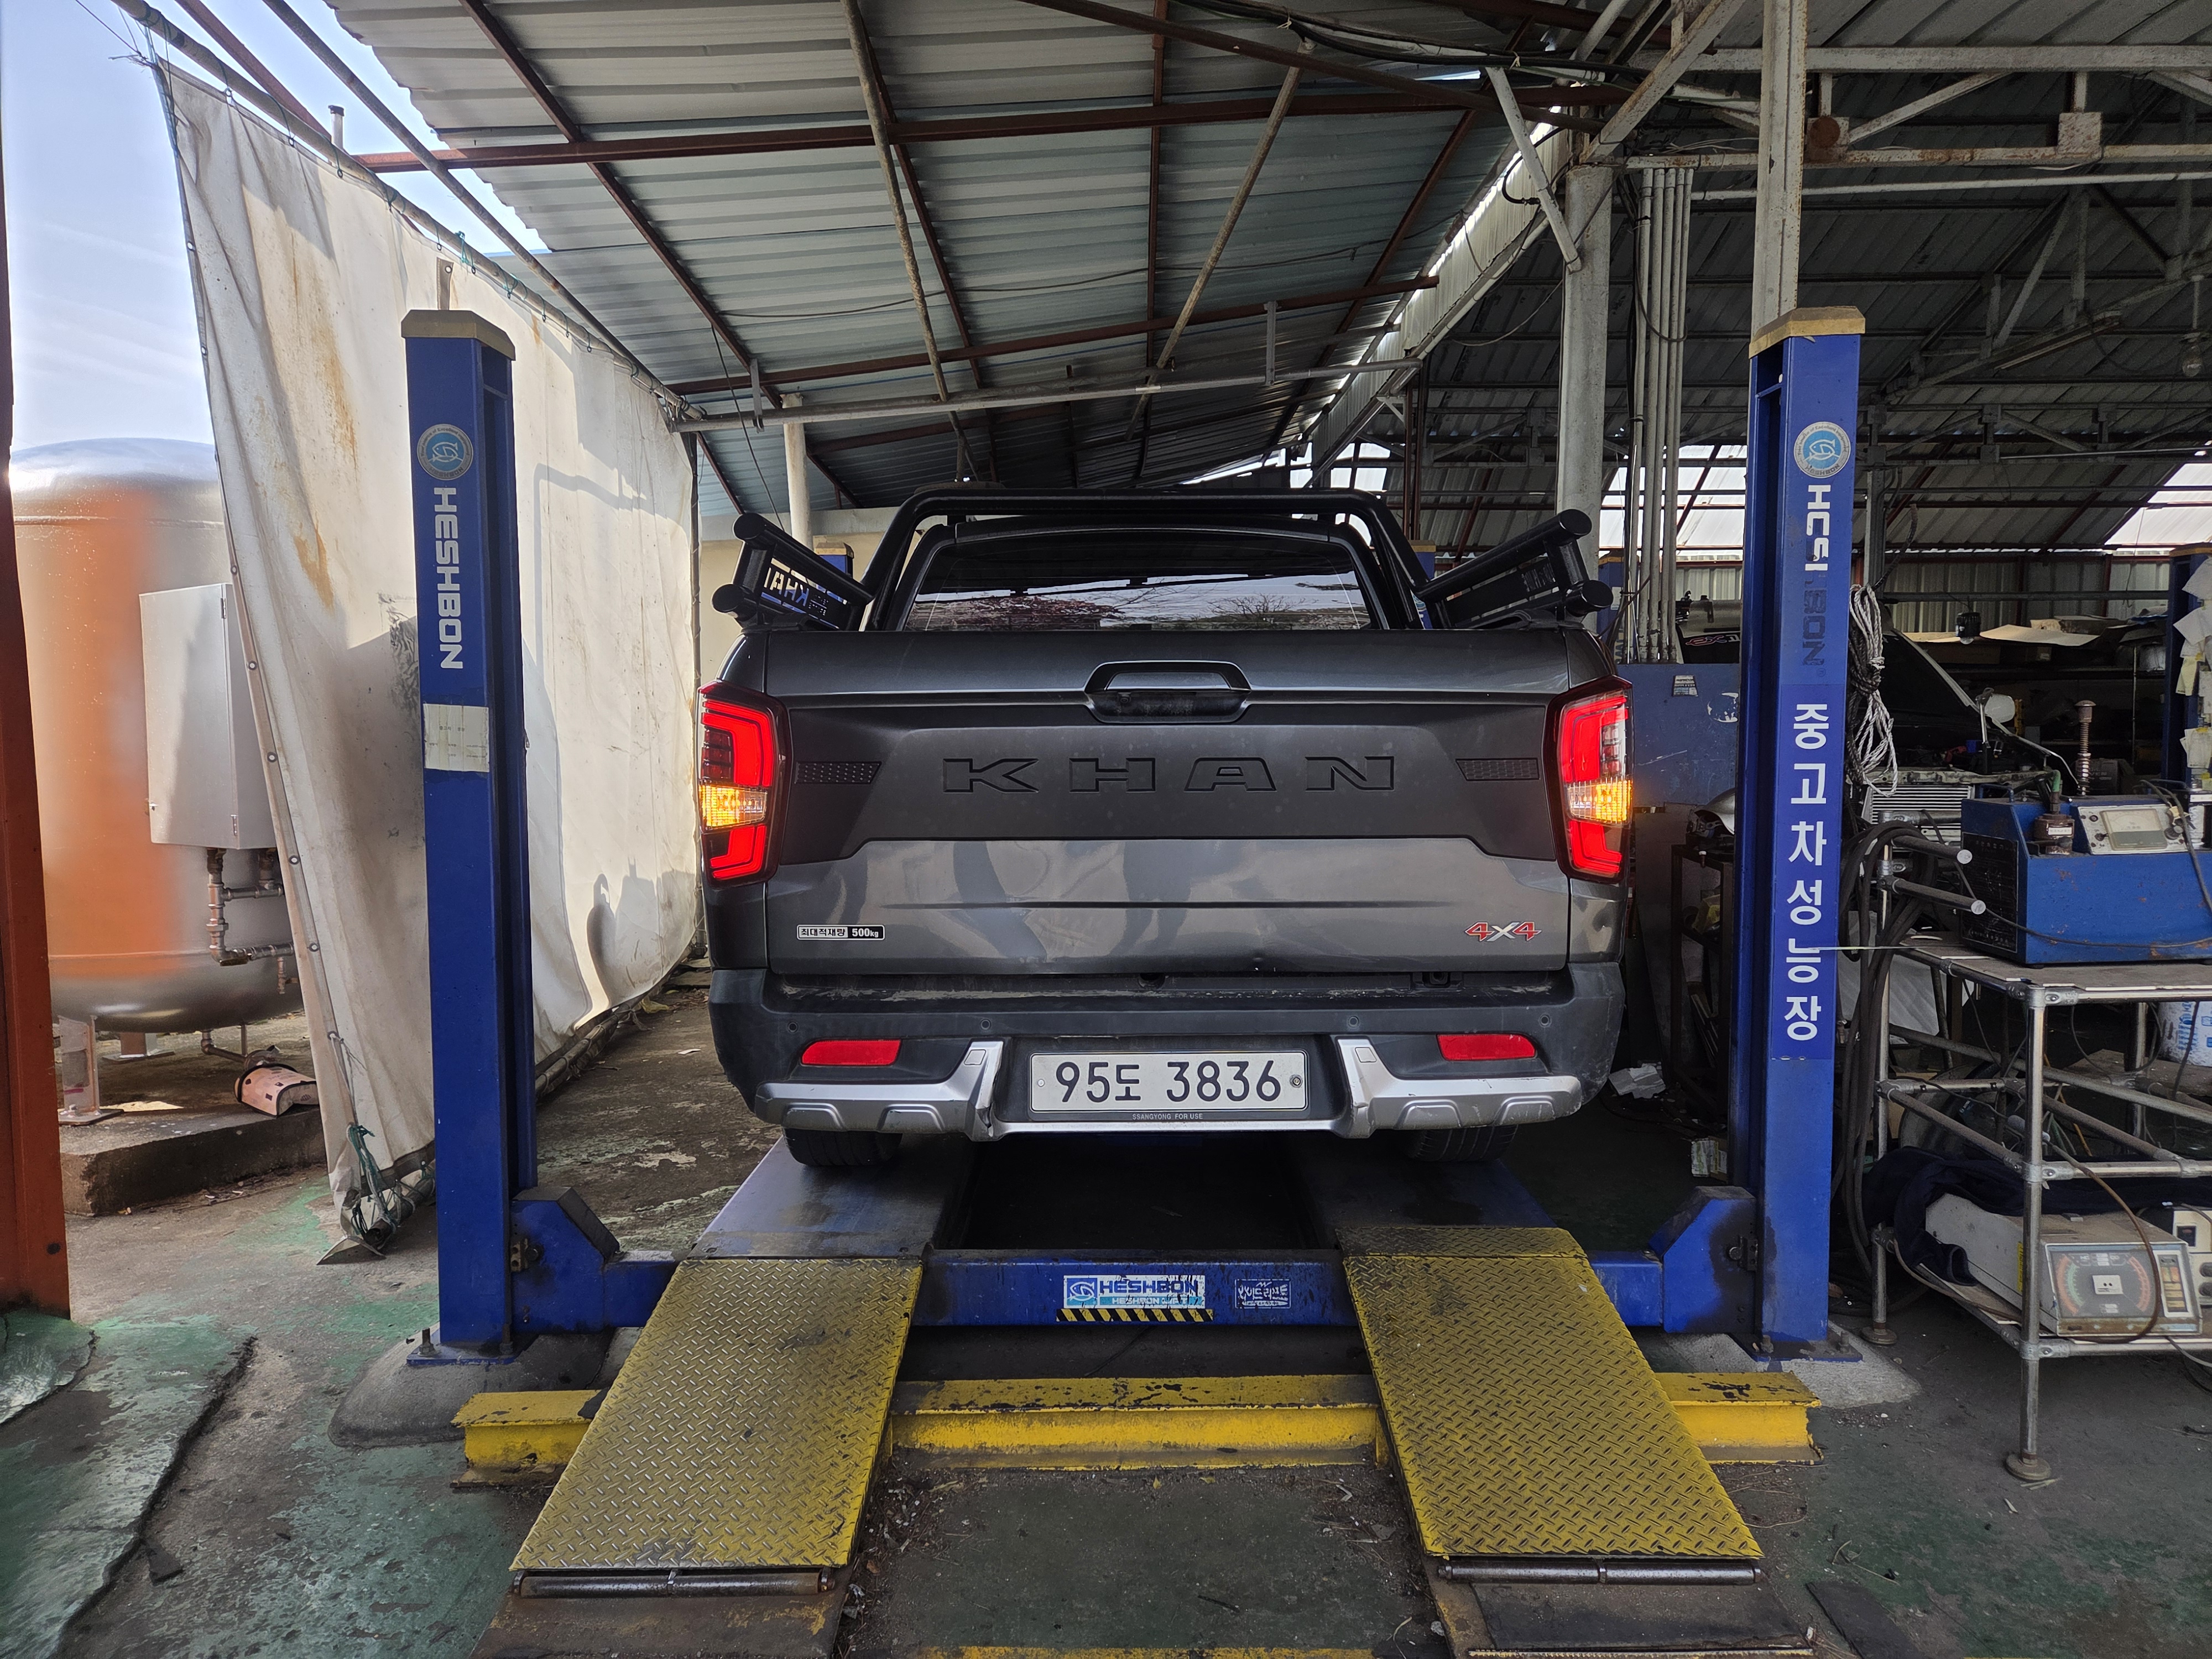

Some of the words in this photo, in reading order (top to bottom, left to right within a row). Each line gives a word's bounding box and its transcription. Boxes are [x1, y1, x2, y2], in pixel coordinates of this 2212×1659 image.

[433, 487, 463, 669] HESHBON
[942, 755, 1395, 793] KHAN
[801, 928, 846, 937] 최대적재량
[852, 928, 879, 938] 500kg
[1055, 1061, 1141, 1103] 95도
[1166, 1060, 1282, 1103] 3836
[1099, 1280, 1198, 1294] HESHBON
